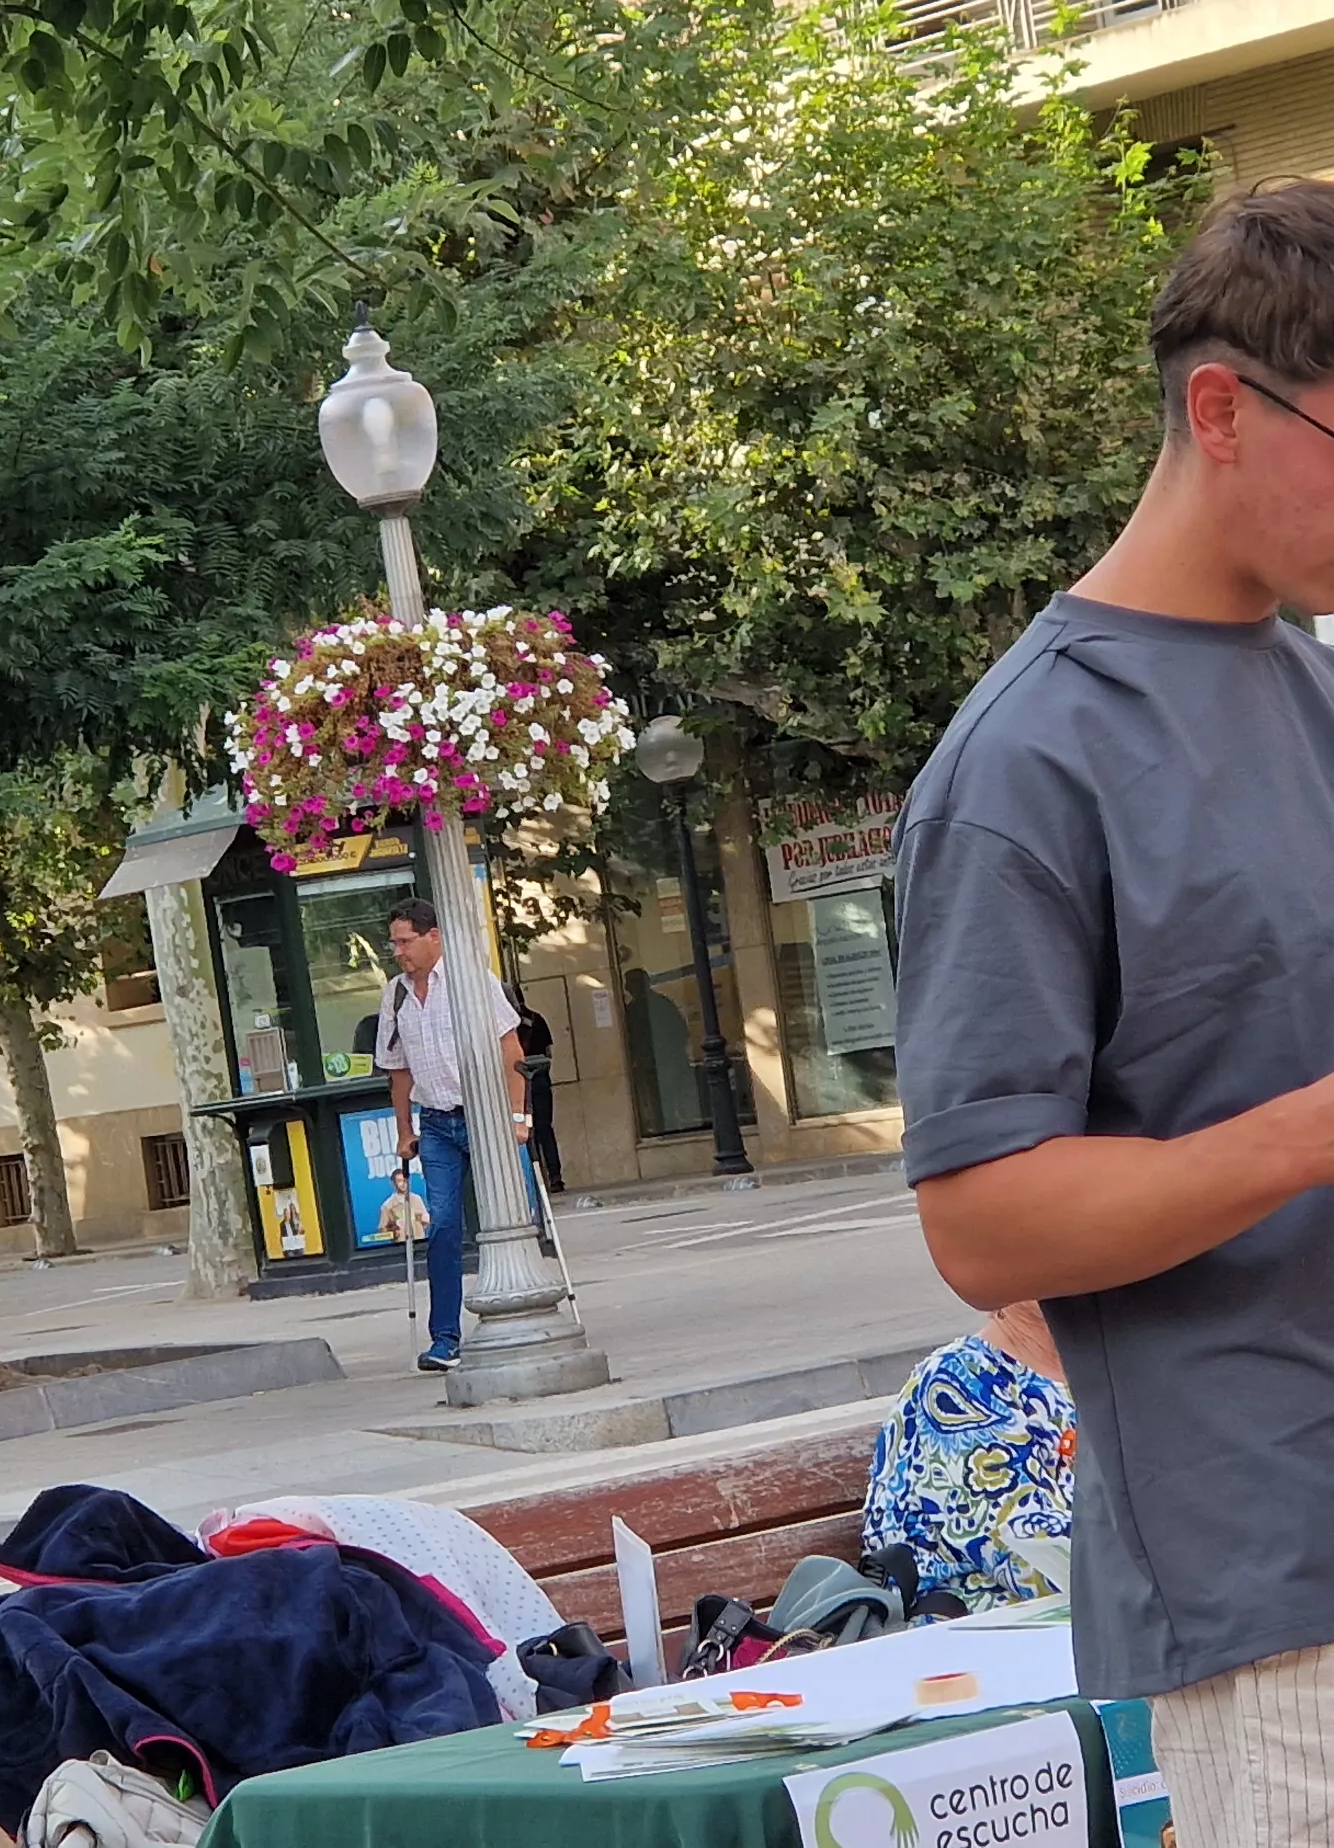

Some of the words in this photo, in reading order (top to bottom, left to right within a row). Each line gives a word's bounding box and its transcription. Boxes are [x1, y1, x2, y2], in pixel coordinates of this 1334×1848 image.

[930, 1774, 1030, 1820] centro
[1035, 1761, 1073, 1794] de
[936, 1800, 1070, 1848] escucha
